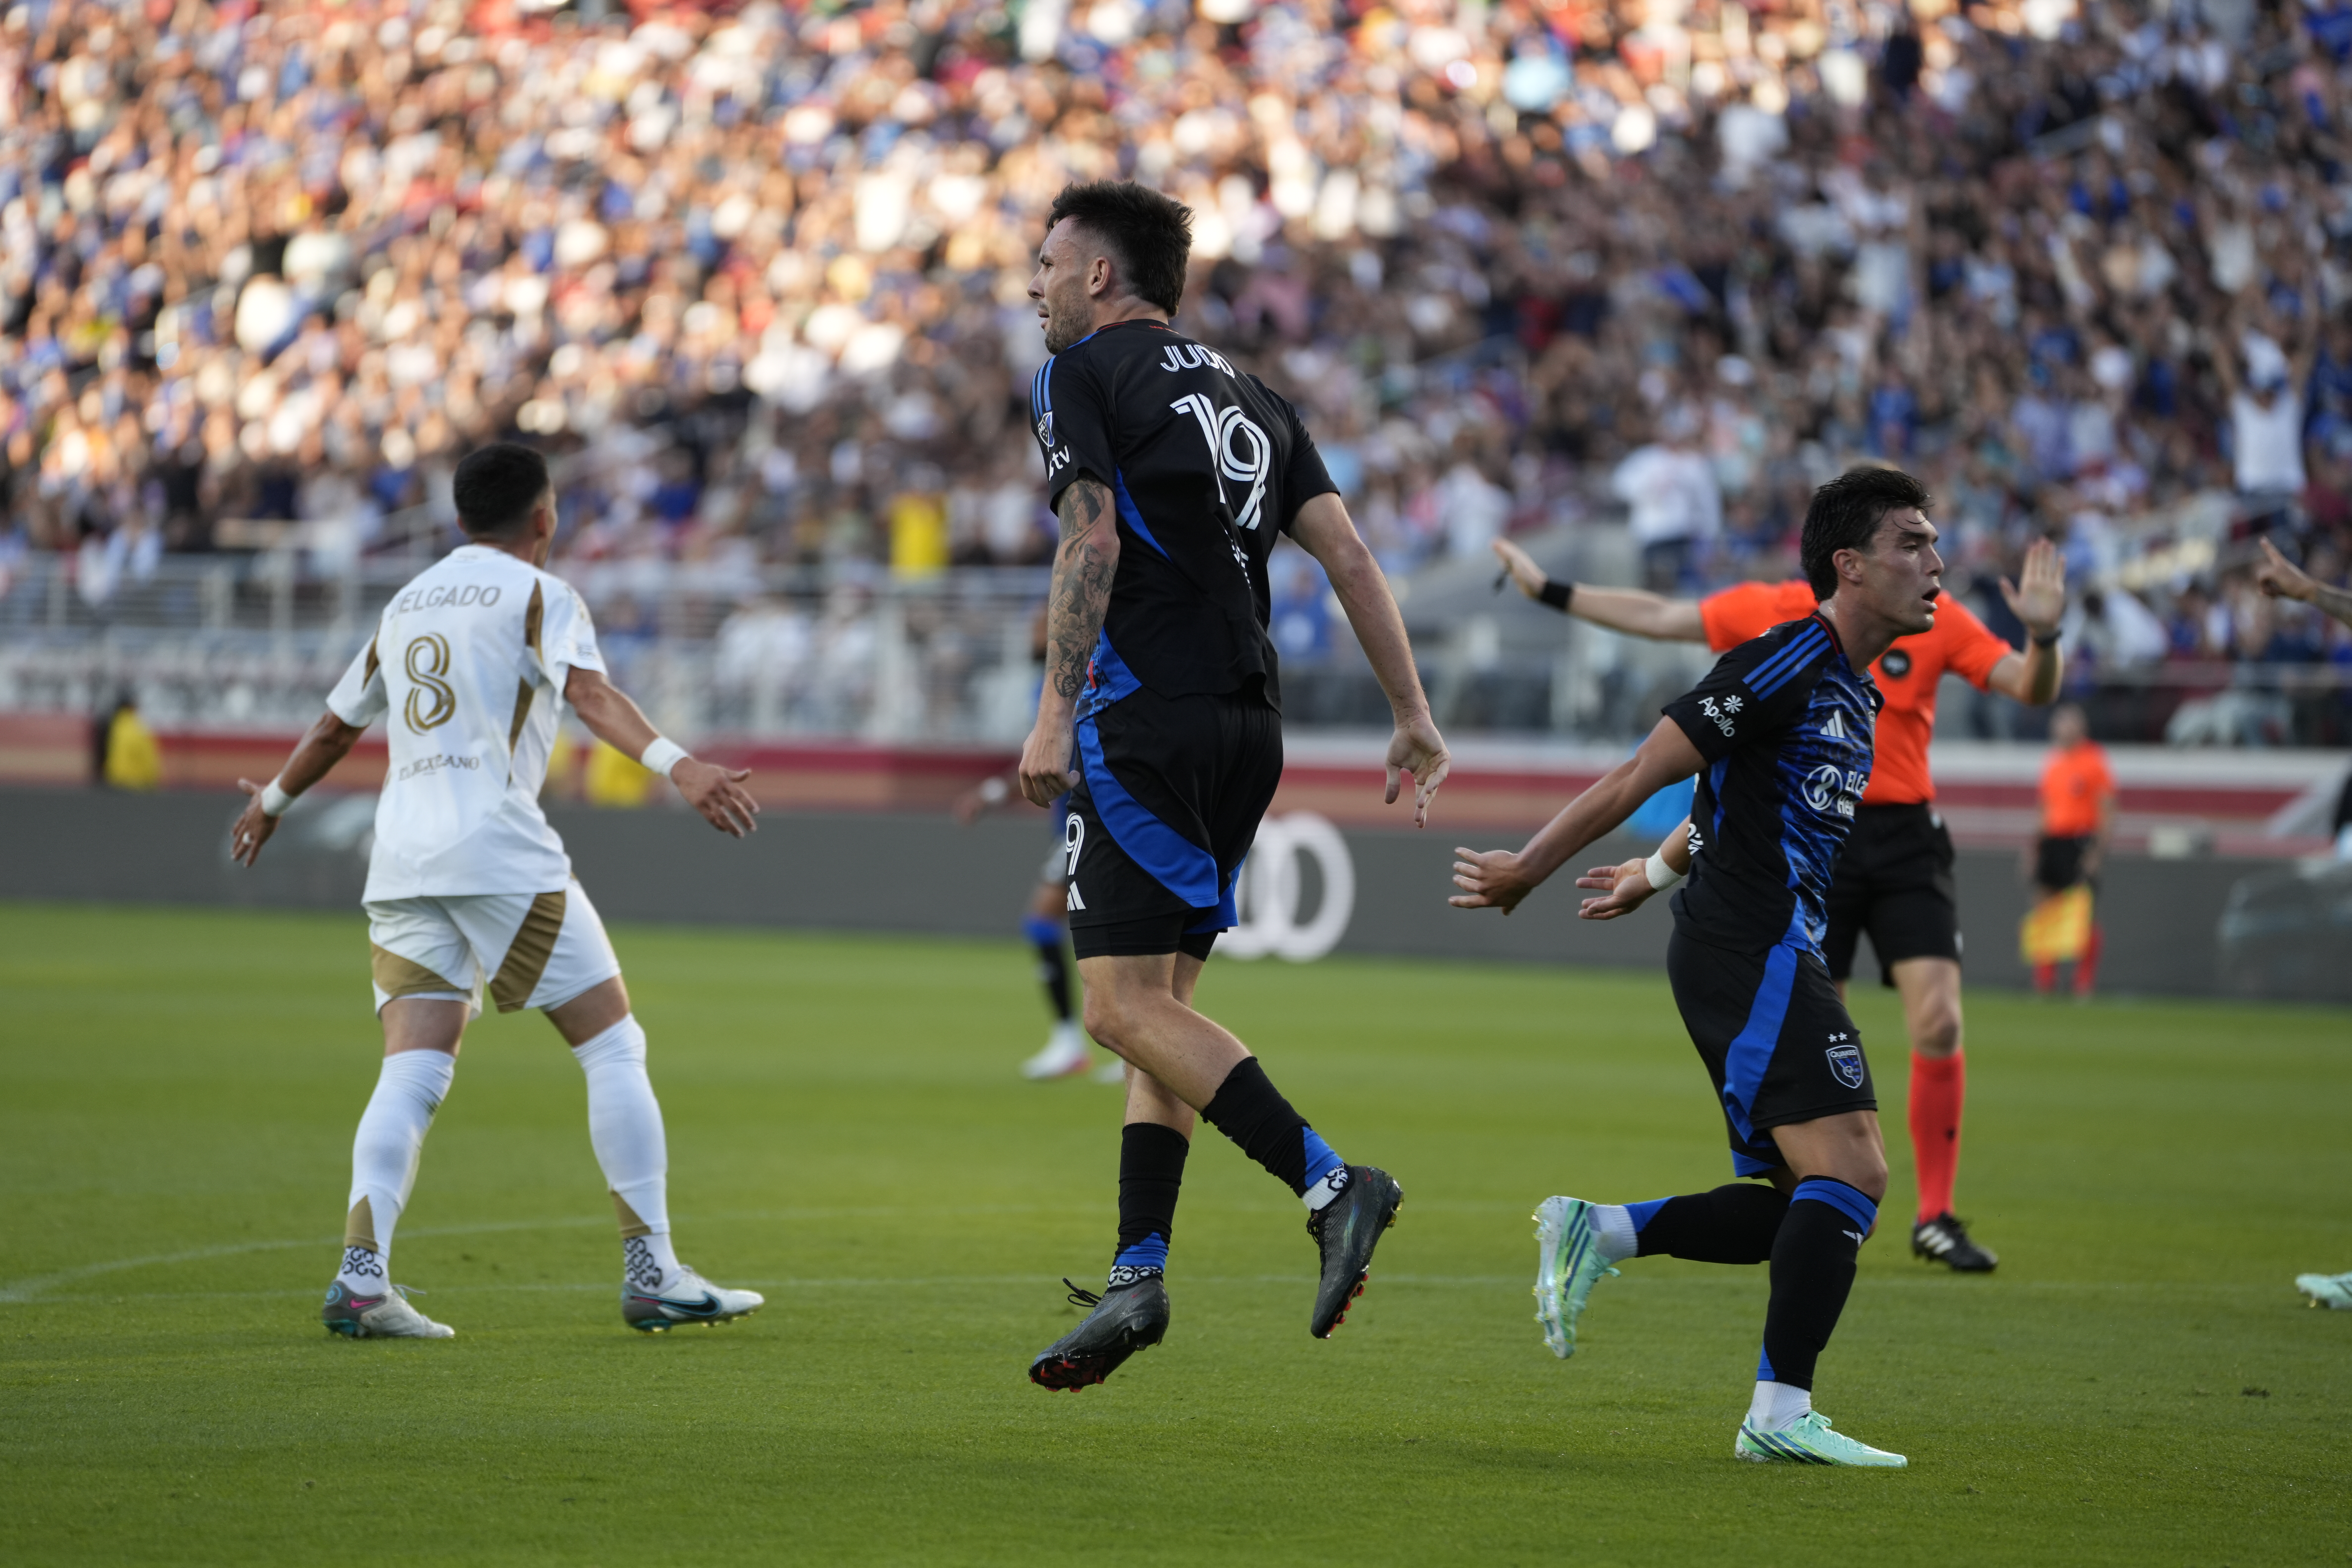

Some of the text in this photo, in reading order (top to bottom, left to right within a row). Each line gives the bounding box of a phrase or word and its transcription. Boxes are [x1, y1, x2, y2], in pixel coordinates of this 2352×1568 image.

[1160, 344, 1235, 378] JUDD
[1169, 393, 1270, 530] 19
[390, 585, 501, 620] ELGADO
[404, 632, 455, 736] 8
[1697, 697, 1735, 737] Apollo
